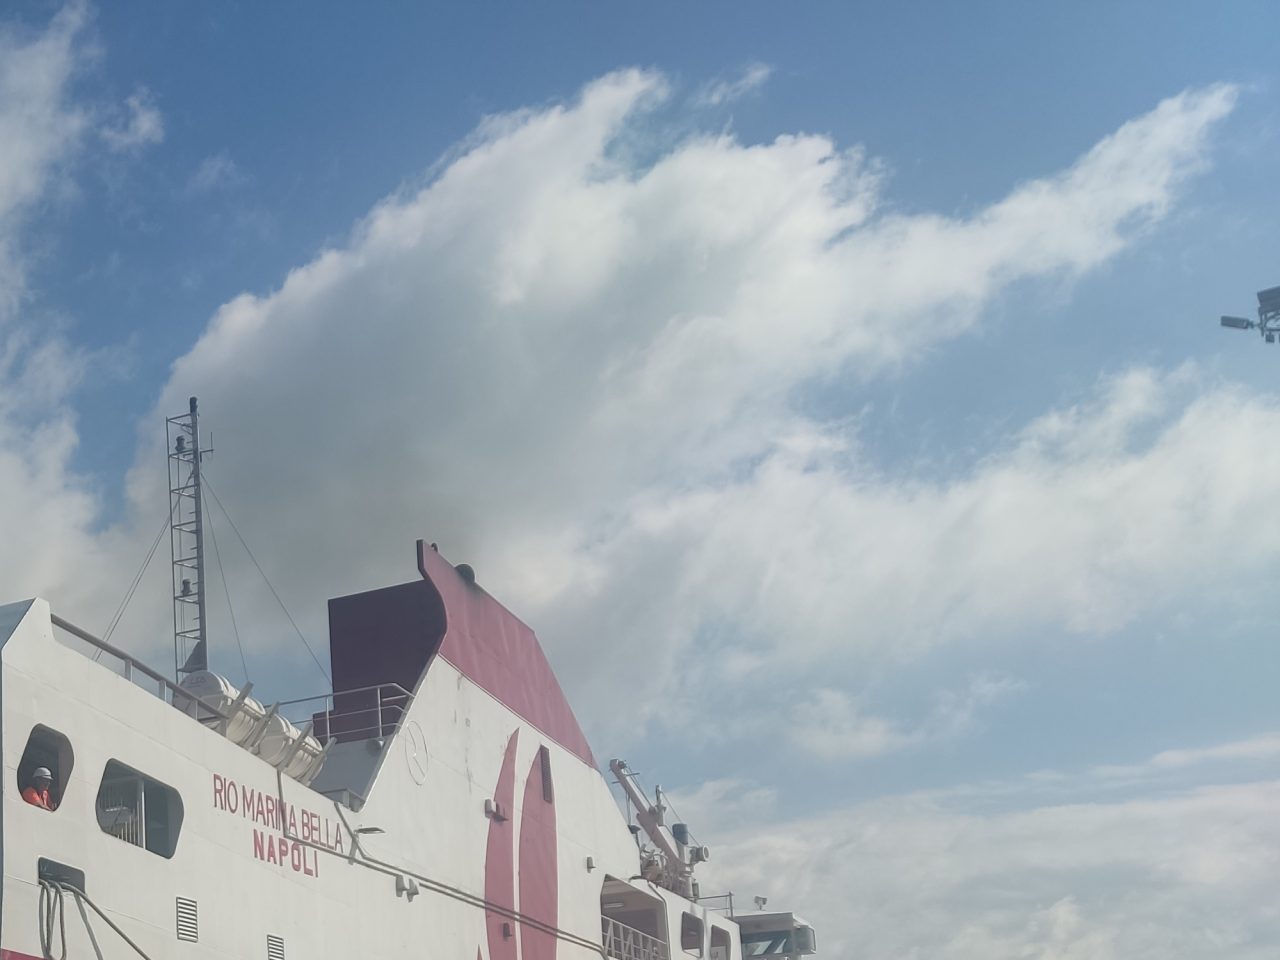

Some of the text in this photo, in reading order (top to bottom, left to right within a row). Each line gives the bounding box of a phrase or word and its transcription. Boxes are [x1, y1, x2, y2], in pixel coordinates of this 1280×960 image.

[213, 773, 344, 854] RIO MARINA BELLA
[253, 828, 319, 878] NAPOLI
